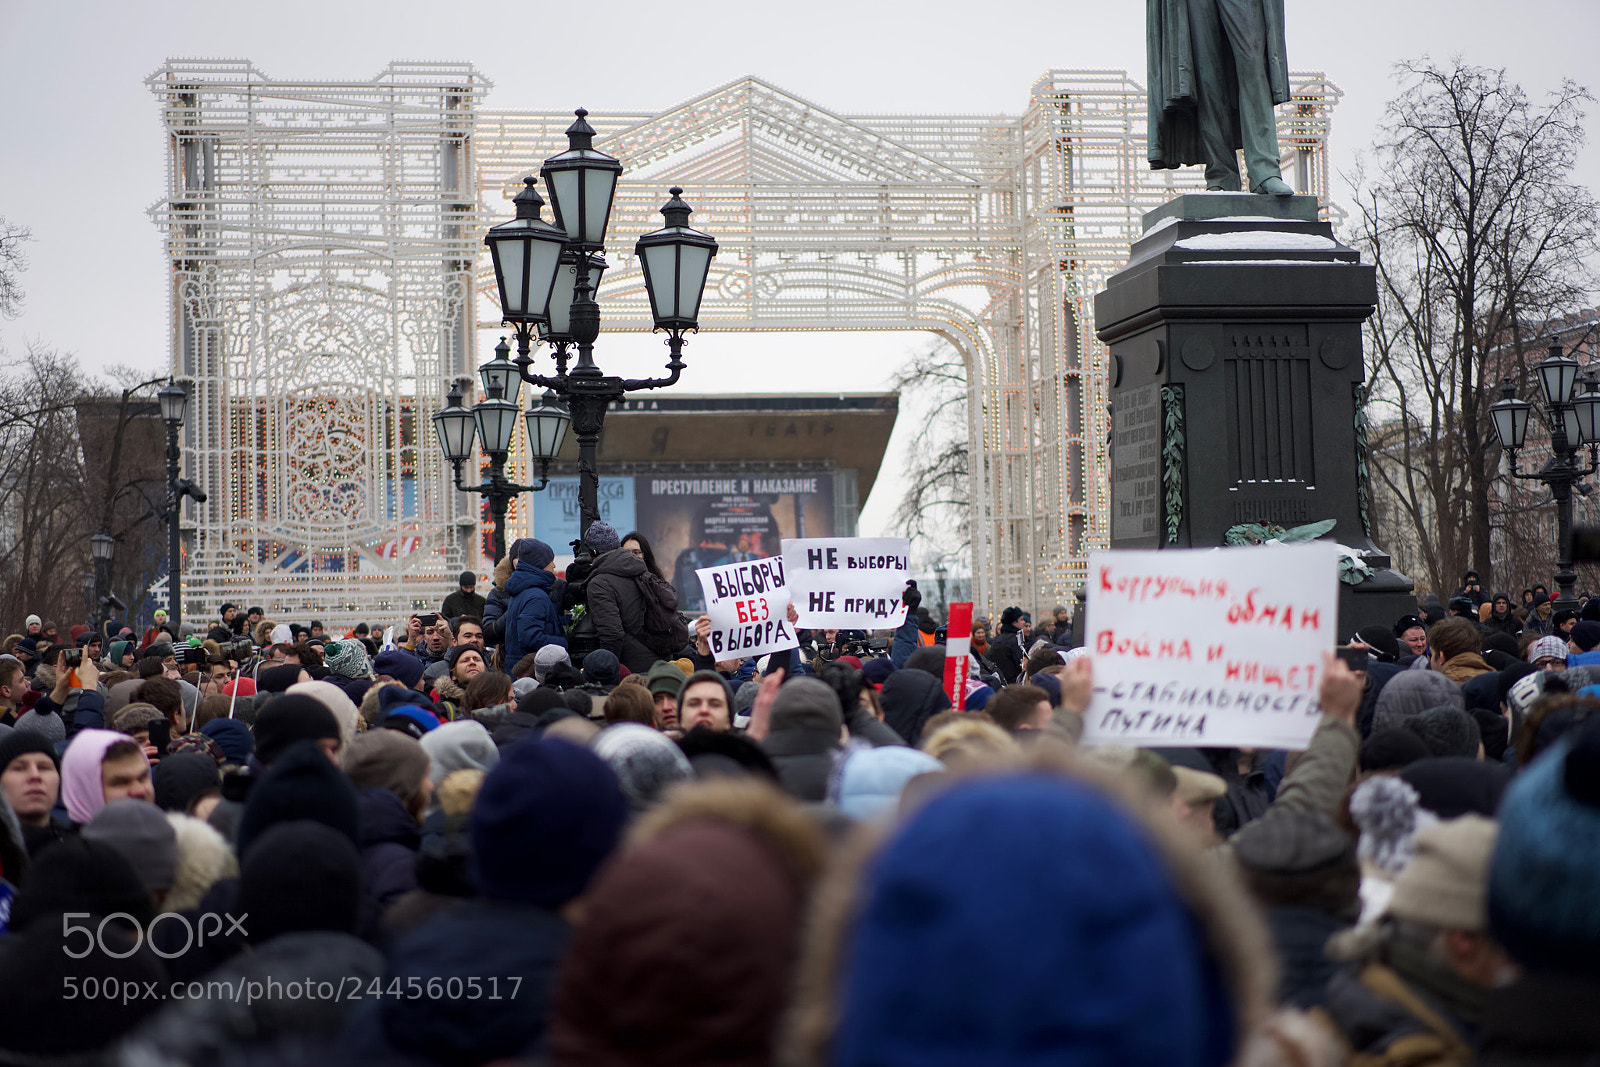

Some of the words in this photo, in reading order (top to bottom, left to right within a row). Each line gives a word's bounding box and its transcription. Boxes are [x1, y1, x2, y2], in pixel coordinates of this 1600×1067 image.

[609, 401, 659, 410] ИКЛА
[652, 479, 738, 495] ПРЕСТУПЛЕНИЕ
[741, 479, 749, 494] И
[753, 478, 818, 494] НАКАЗАНИЕ
[807, 547, 839, 570] НЕ
[847, 555, 907, 571] ВЫБОРЫ
[735, 597, 770, 623] БЕЗ
[808, 591, 836, 613] НЕ
[712, 619, 791, 654] ВЫБОРА
